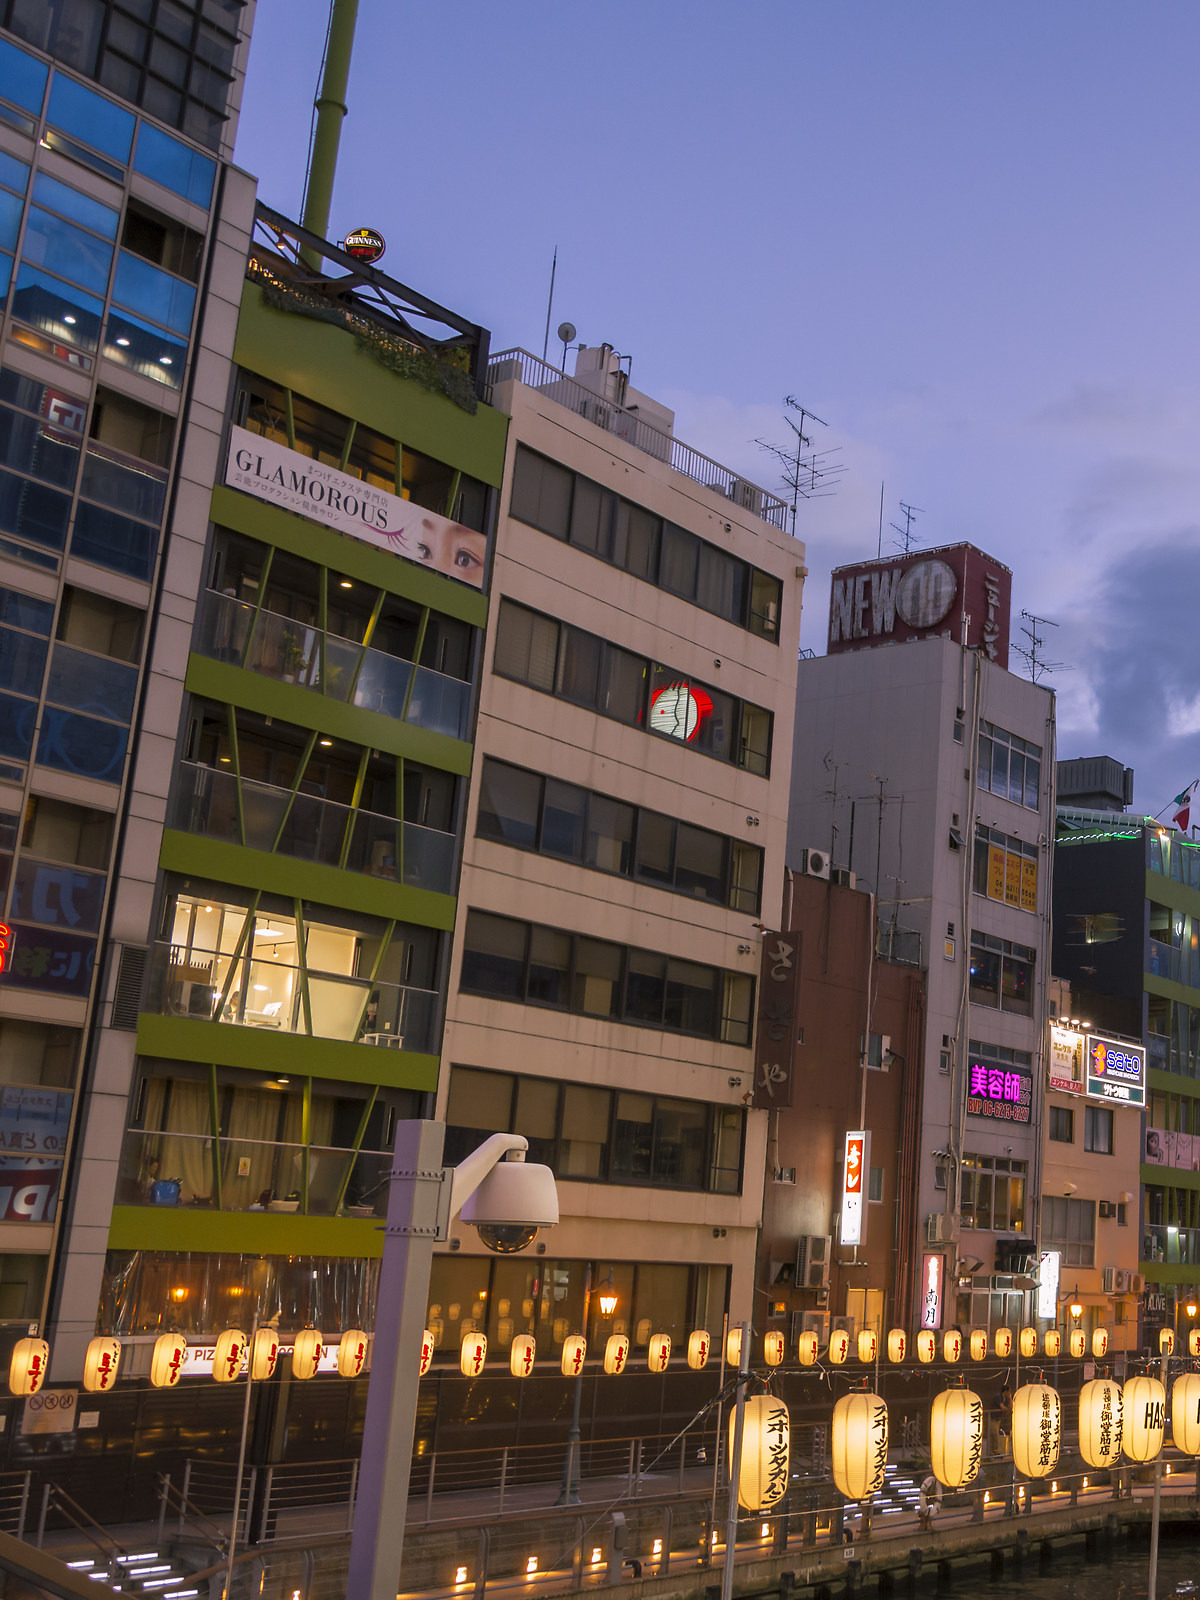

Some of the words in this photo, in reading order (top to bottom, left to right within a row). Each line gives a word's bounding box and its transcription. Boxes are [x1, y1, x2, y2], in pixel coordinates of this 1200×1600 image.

[347, 236, 381, 247] GUINNESS
[236, 449, 388, 530] GLAMOROUS
[831, 568, 902, 642] NEW
[1106, 1049, 1141, 1074] sato
[970, 1064, 1020, 1103] 美容師
